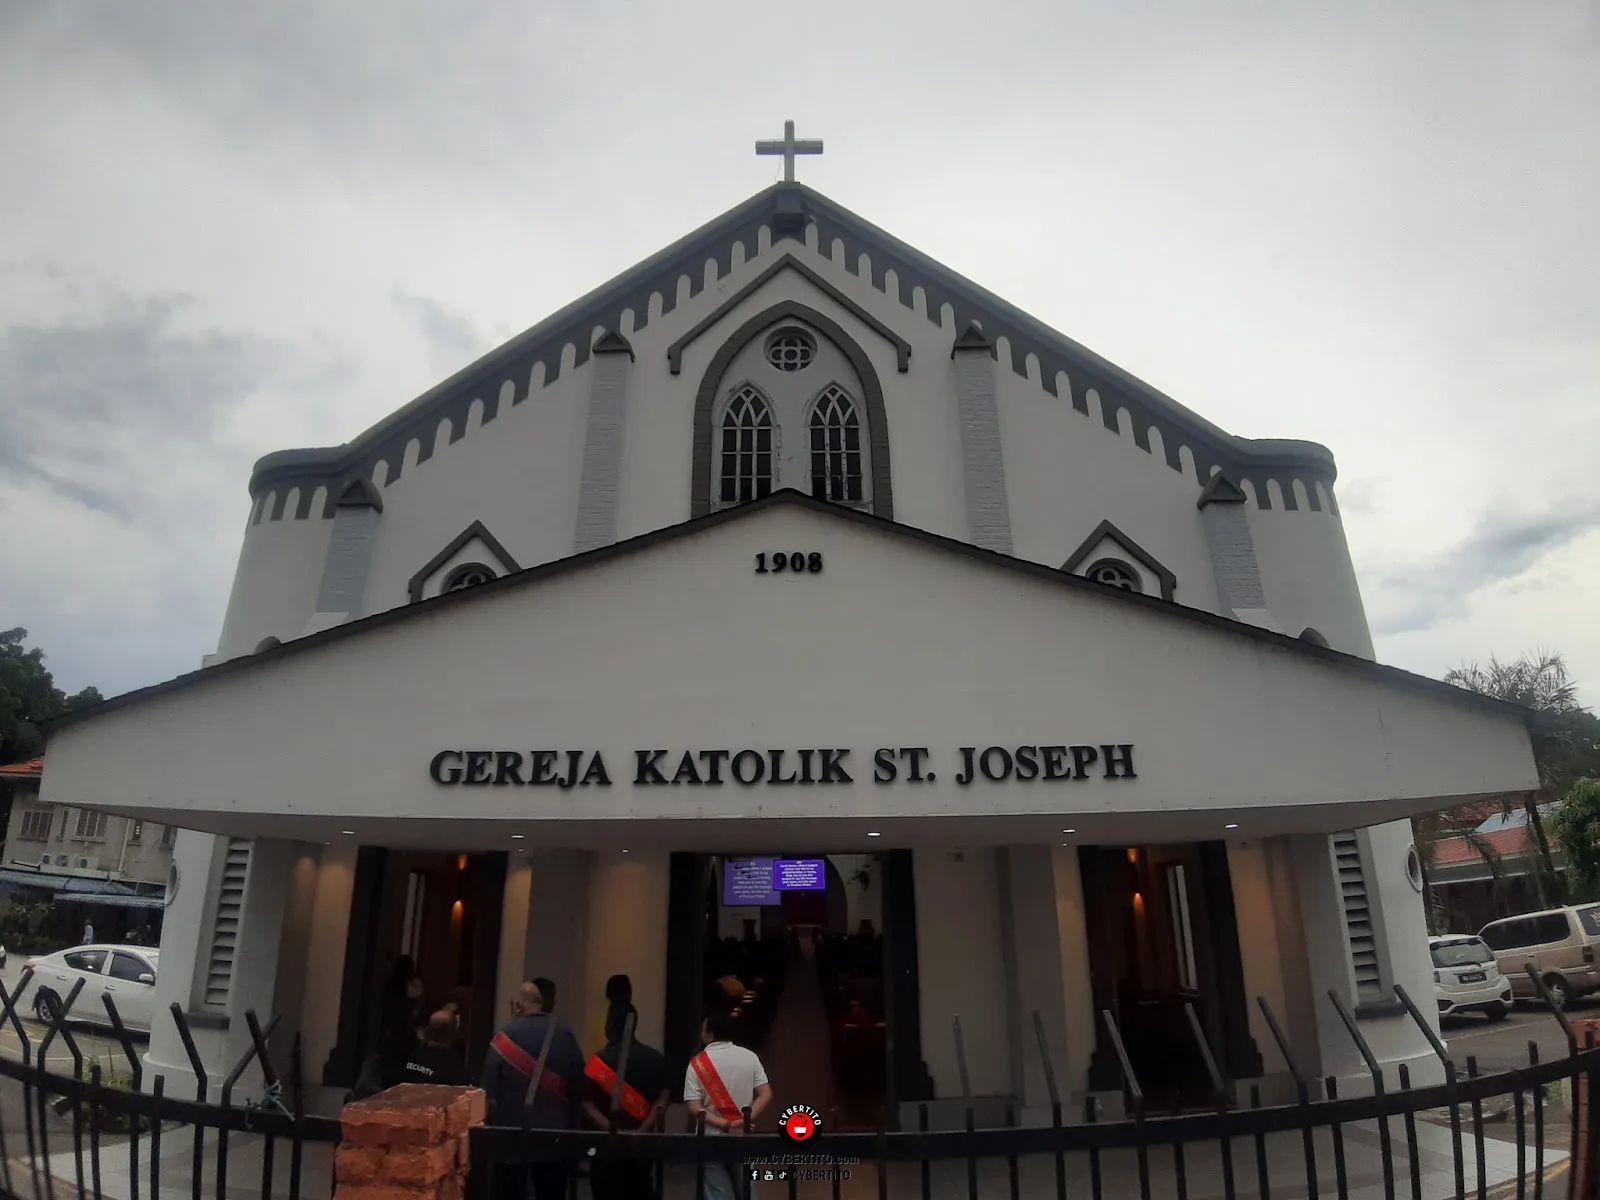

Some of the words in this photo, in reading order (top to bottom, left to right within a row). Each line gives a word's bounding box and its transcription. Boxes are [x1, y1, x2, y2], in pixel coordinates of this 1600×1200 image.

[755, 551, 823, 573] 1908
[429, 750, 613, 788] GEREJA
[633, 749, 853, 785] KATOLIK
[874, 747, 936, 784] ST.
[956, 744, 1137, 785] JOSEPH
[405, 1061, 434, 1077] SECURITY
